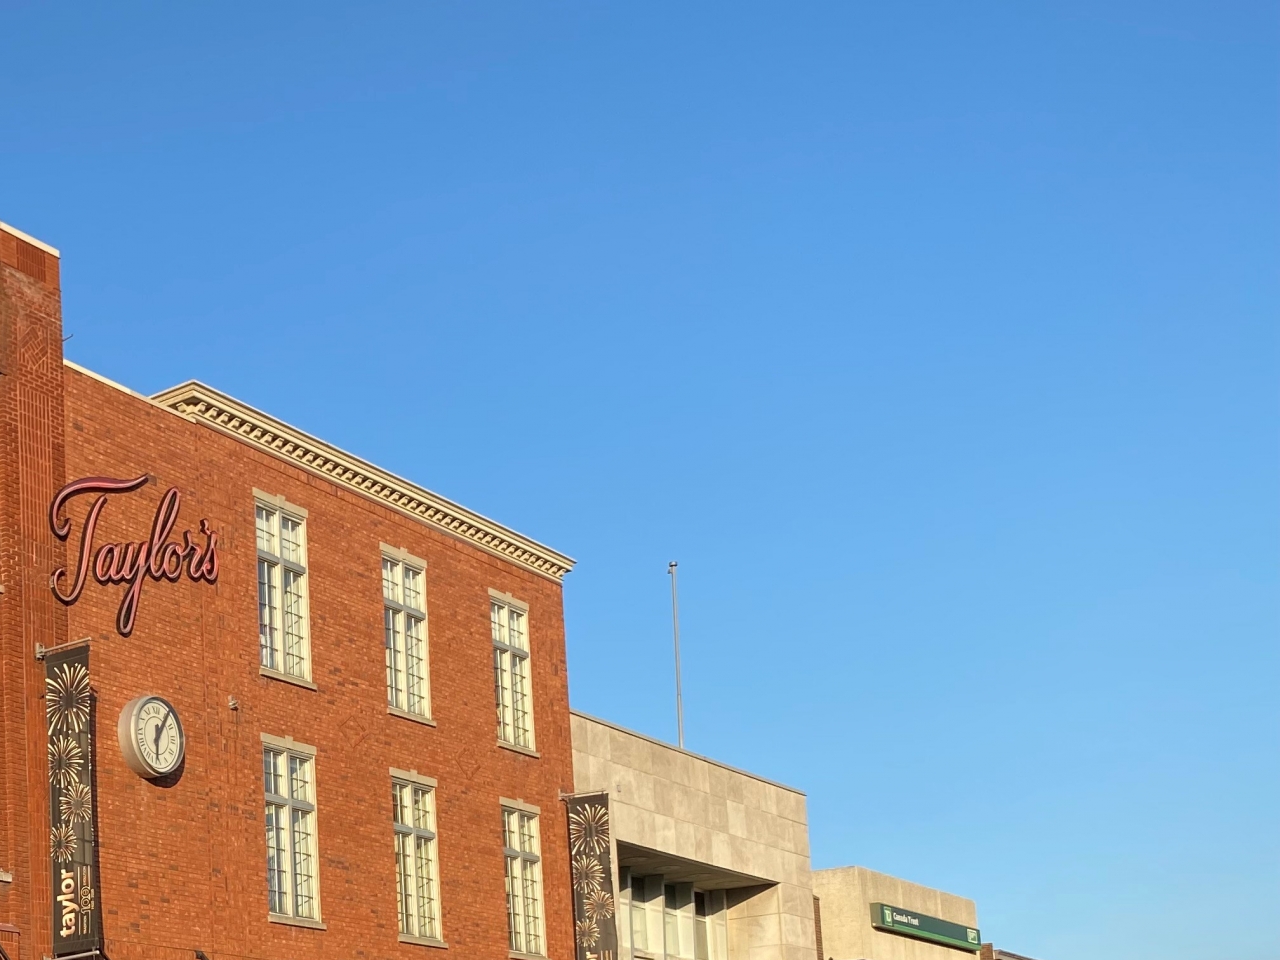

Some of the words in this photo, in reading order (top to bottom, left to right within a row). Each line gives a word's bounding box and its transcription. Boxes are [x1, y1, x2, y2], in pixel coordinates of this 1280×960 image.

[49, 473, 219, 638] Taylor's
[57, 869, 80, 938] taylor
[893, 912, 908, 924] Canada
